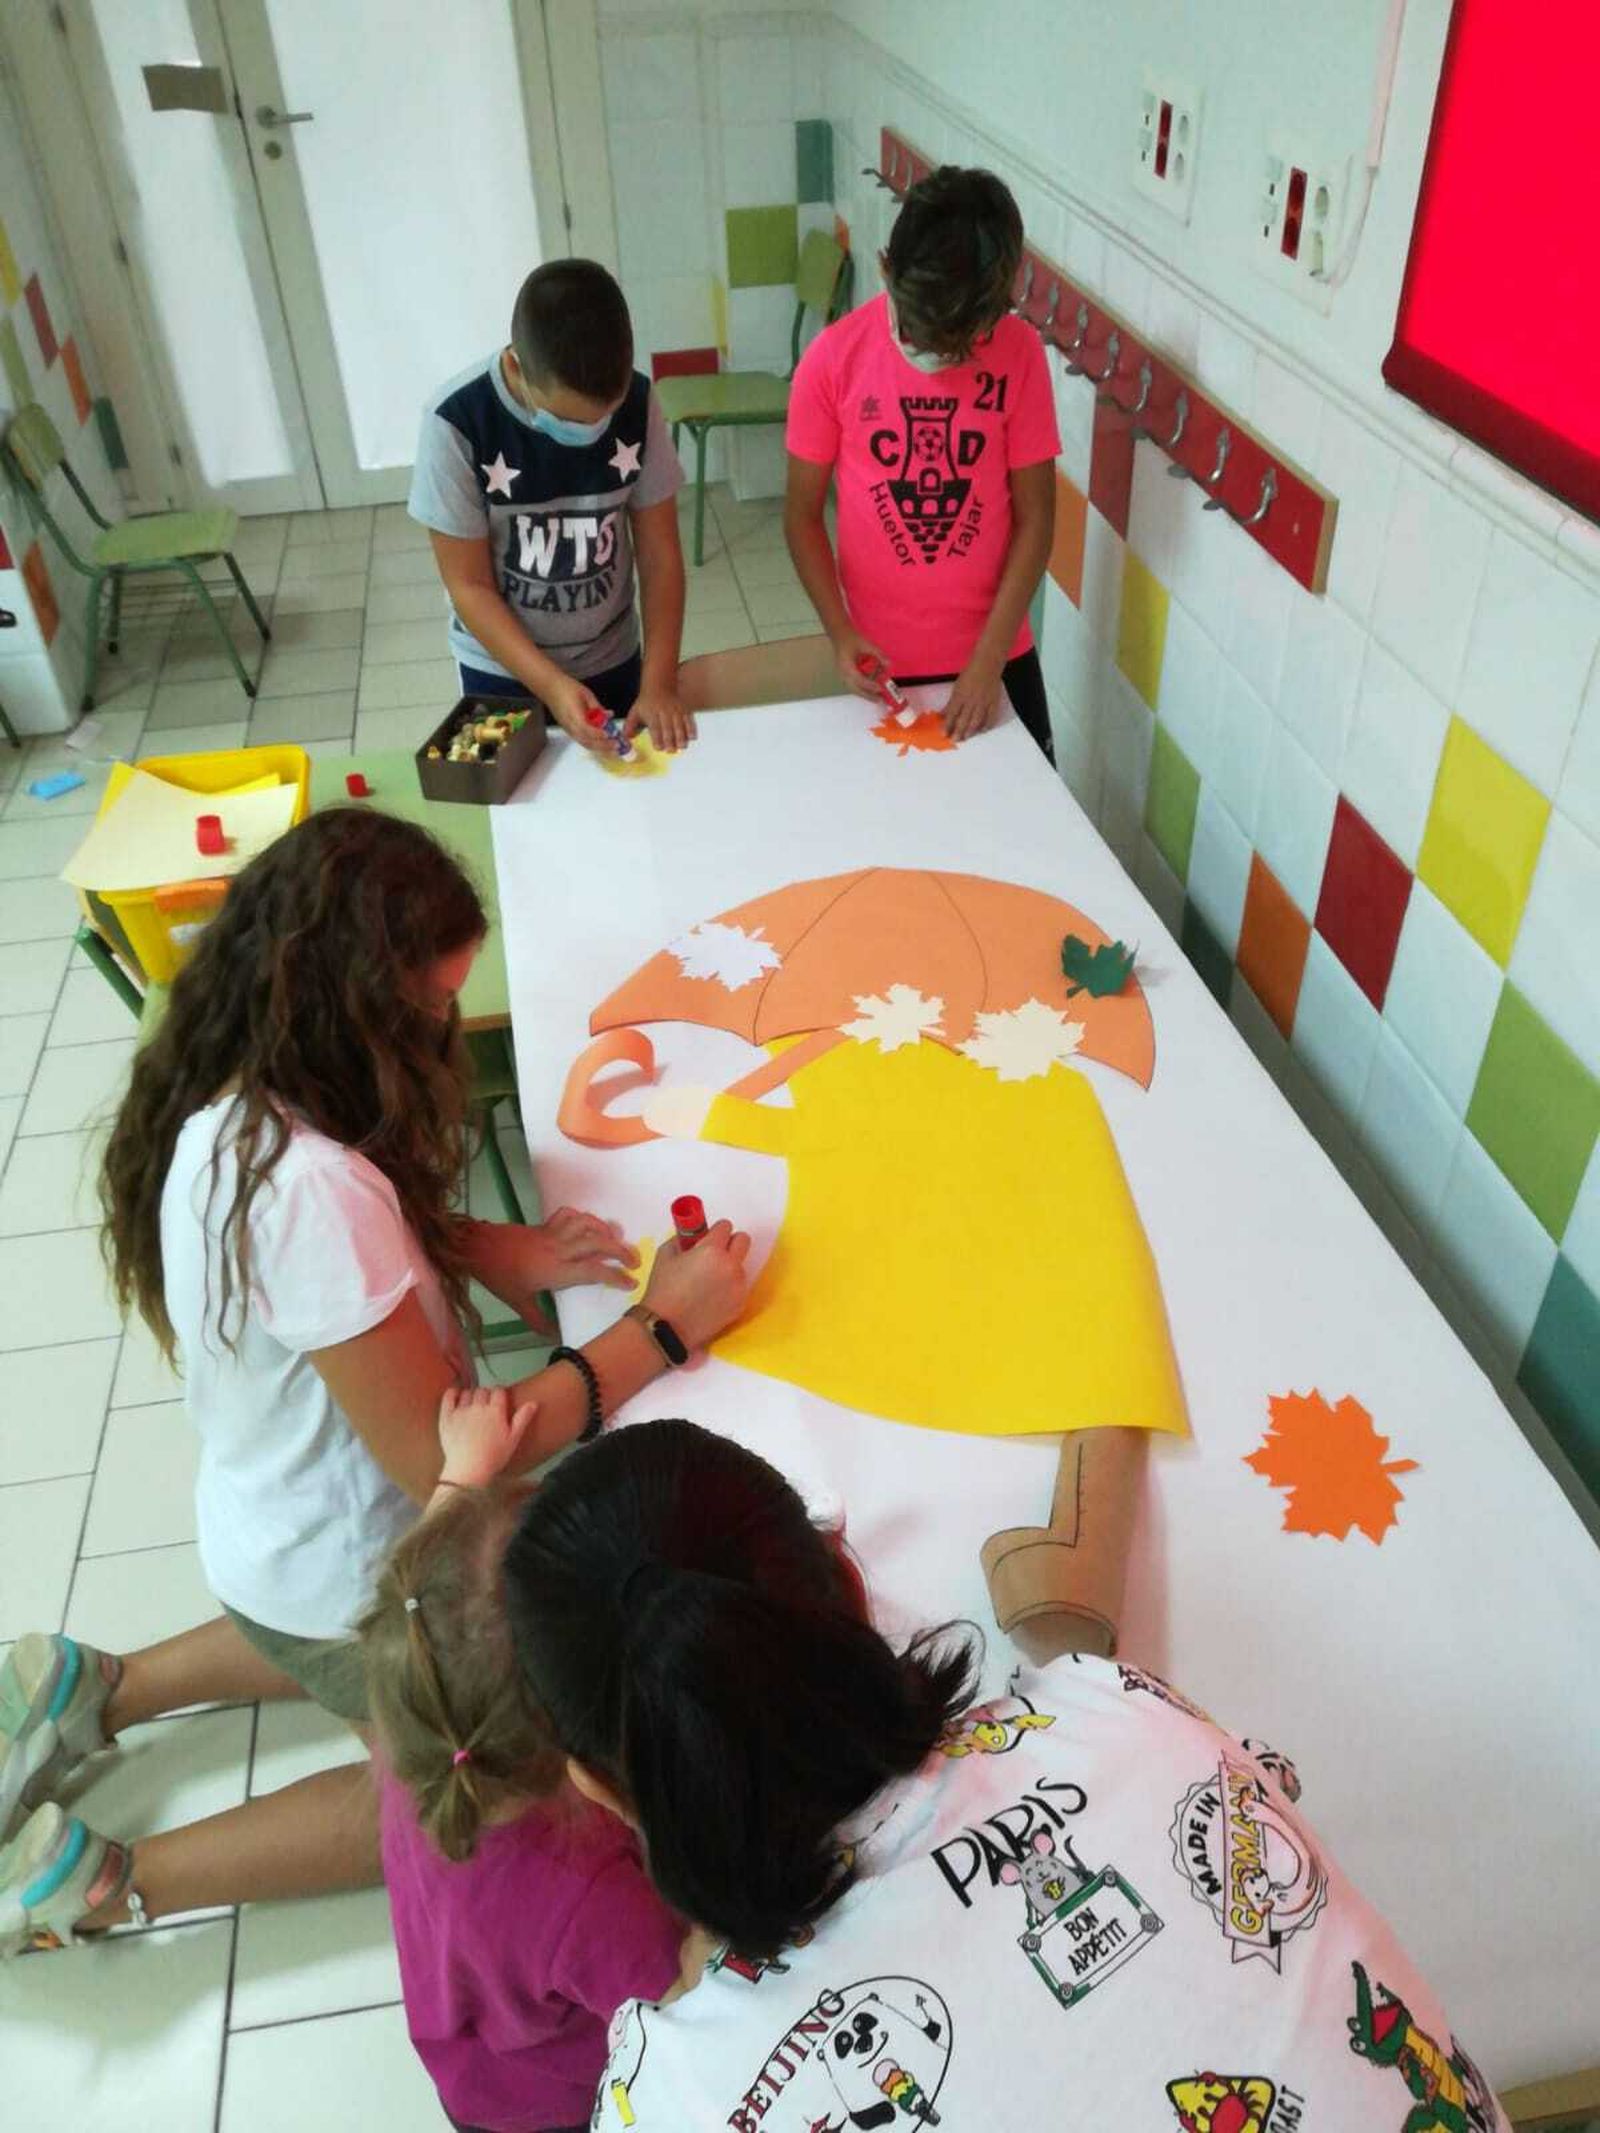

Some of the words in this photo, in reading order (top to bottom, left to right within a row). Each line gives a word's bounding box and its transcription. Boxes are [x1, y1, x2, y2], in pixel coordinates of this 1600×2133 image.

[974, 371, 1008, 413] 21
[869, 429, 900, 467] C
[957, 430, 987, 467] D
[869, 480, 916, 566] Huetor
[947, 496, 985, 558] Tajar
[1196, 1791, 1221, 1818] IN
[930, 1776, 1088, 1909] PARIS
[1188, 1819, 1222, 1895] MADE
[1064, 1907, 1101, 1942] BON
[1068, 1917, 1128, 1976] APPÉTIT
[727, 1989, 845, 2133] BEIJING
